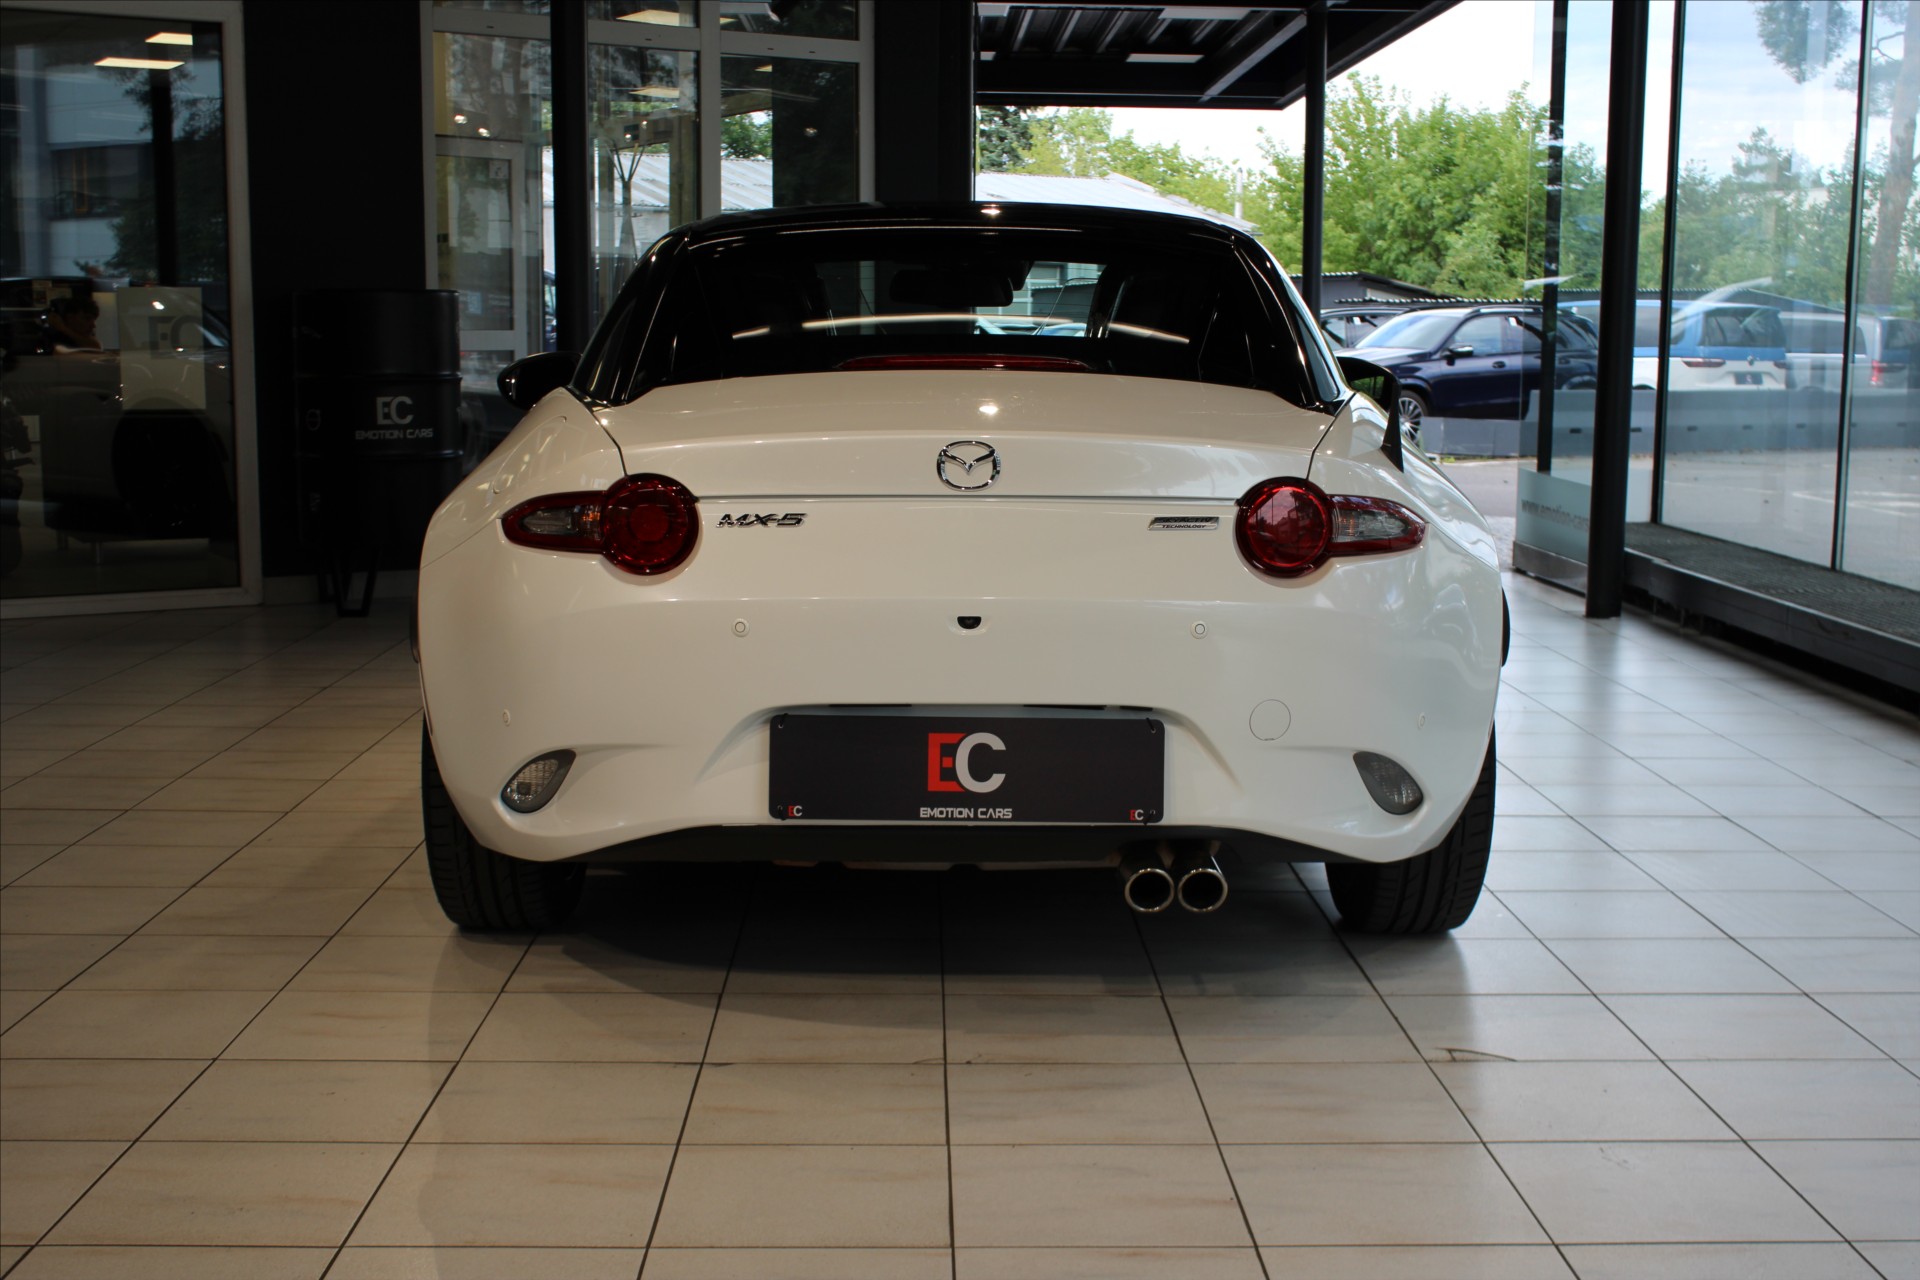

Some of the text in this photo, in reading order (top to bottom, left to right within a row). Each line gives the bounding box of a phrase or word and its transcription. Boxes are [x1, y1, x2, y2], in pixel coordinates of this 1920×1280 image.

[376, 395, 414, 425] EC
[355, 428, 434, 440] EMOTION CARS
[717, 513, 807, 527] MX-5
[927, 732, 1006, 793] EC
[788, 805, 802, 817] EC
[919, 807, 1013, 819] EMOTION CARS
[1130, 809, 1144, 821] EC
